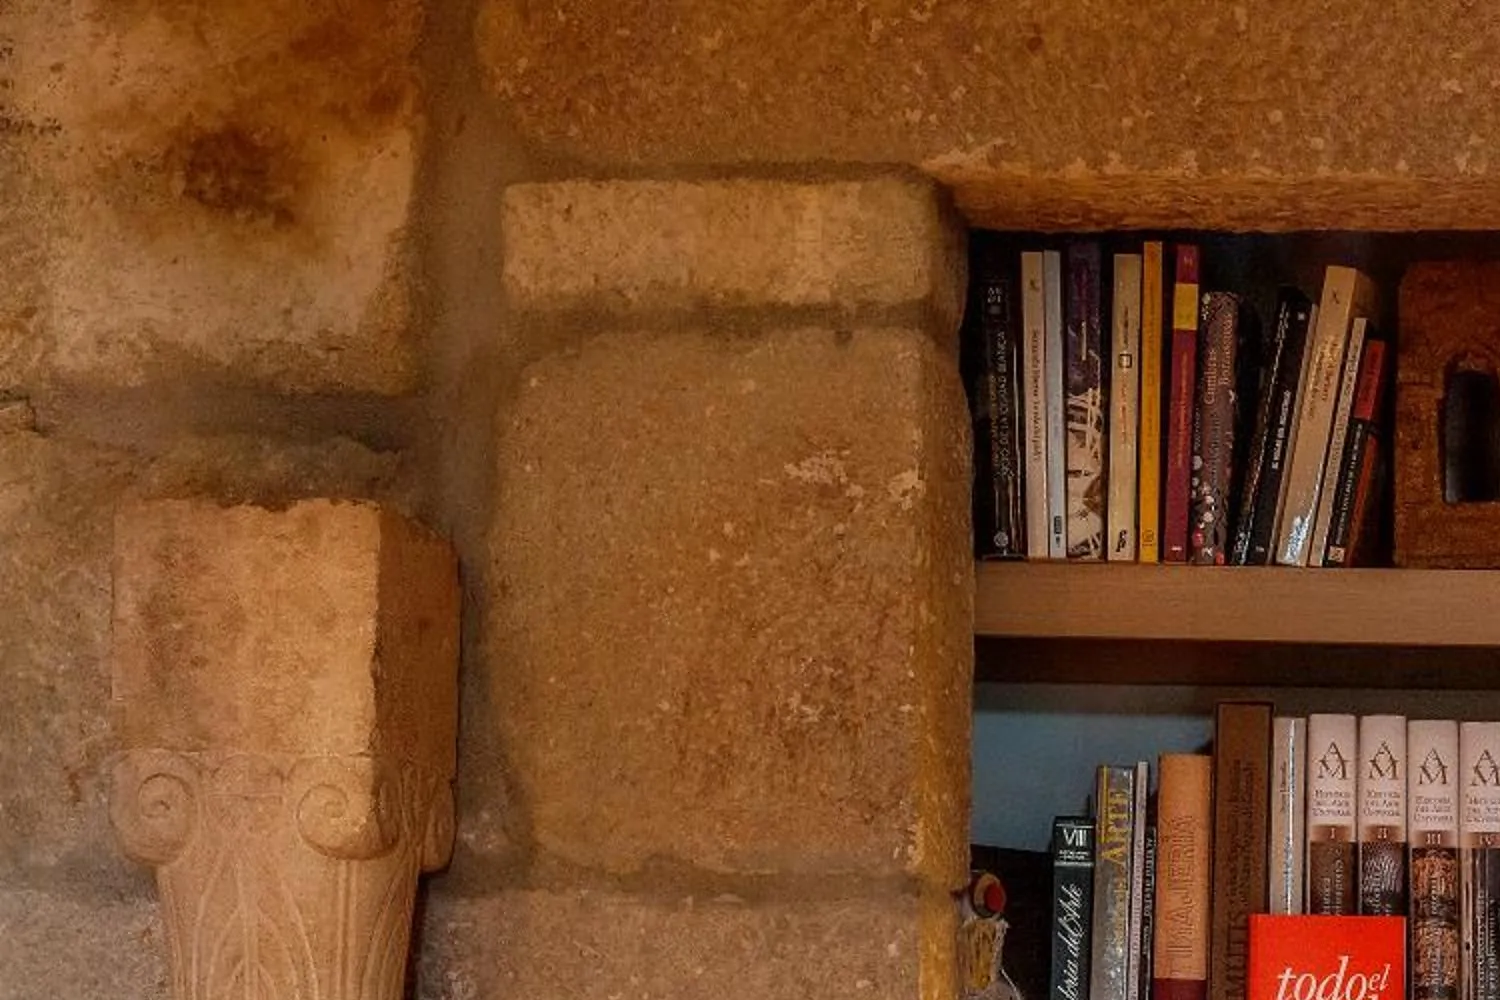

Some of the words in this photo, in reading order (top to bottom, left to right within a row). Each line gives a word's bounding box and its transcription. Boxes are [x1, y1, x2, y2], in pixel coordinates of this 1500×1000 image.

[1102, 786, 1132, 866] ARTE
[1330, 827, 1336, 839] I
[1378, 827, 1388, 839] II
[1063, 828, 1087, 847] VIII
[1426, 833, 1441, 845] III
[1368, 963, 1391, 991] el
